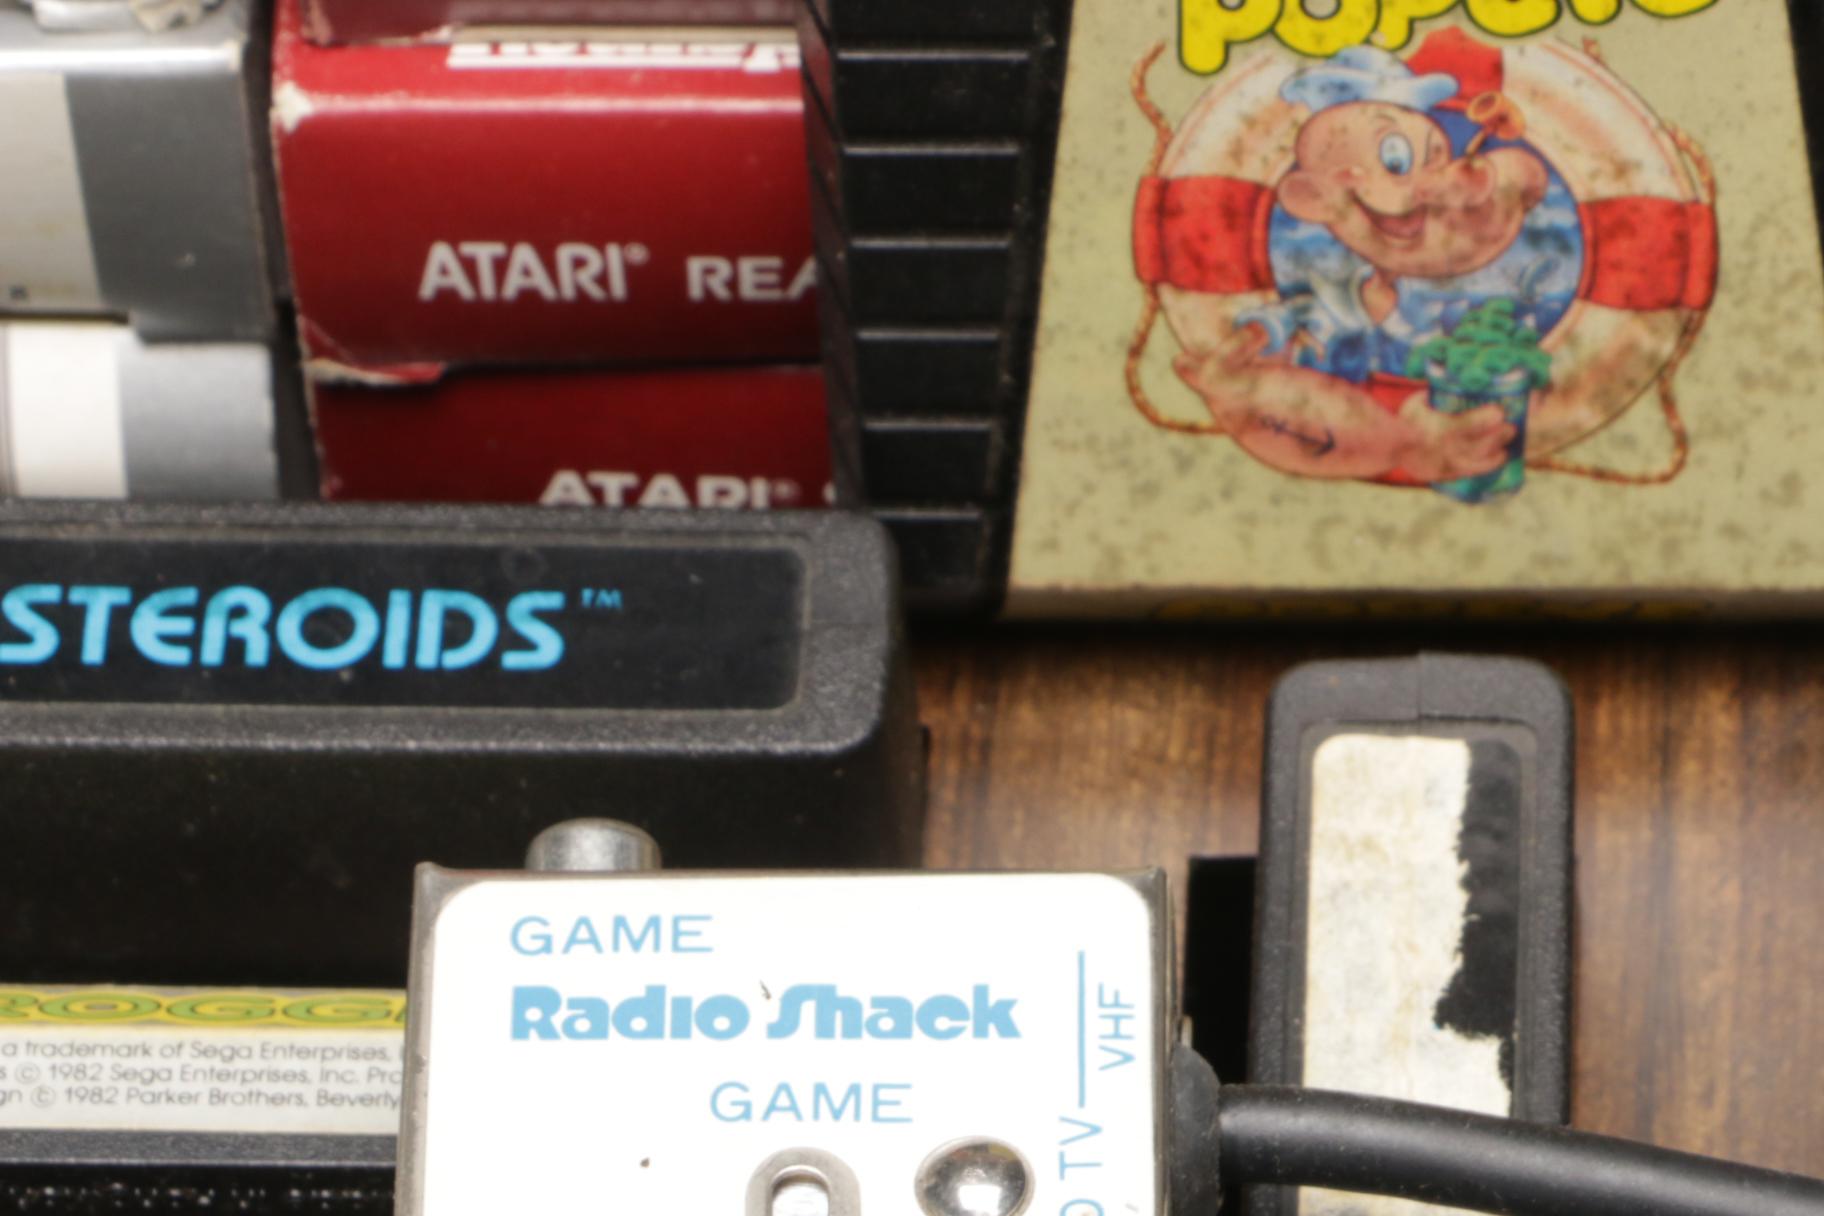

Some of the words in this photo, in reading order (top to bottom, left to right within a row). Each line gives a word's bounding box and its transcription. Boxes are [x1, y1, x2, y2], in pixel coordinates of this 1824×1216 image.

[510, 914, 713, 956] GAME
[511, 984, 749, 1041] Radio
[766, 982, 1022, 1041] Shack
[1097, 983, 1137, 1071] VHF
[25, 1040, 153, 1059] trademark
[159, 1040, 186, 1059] of
[191, 1041, 253, 1063] Sega
[49, 1062, 103, 1082] 1982
[109, 1063, 173, 1085] Sega
[64, 1086, 119, 1104] 1982
[126, 1086, 201, 1104] Parker
[709, 1081, 913, 1124] GAME
[1057, 1116, 1103, 1181] TV
